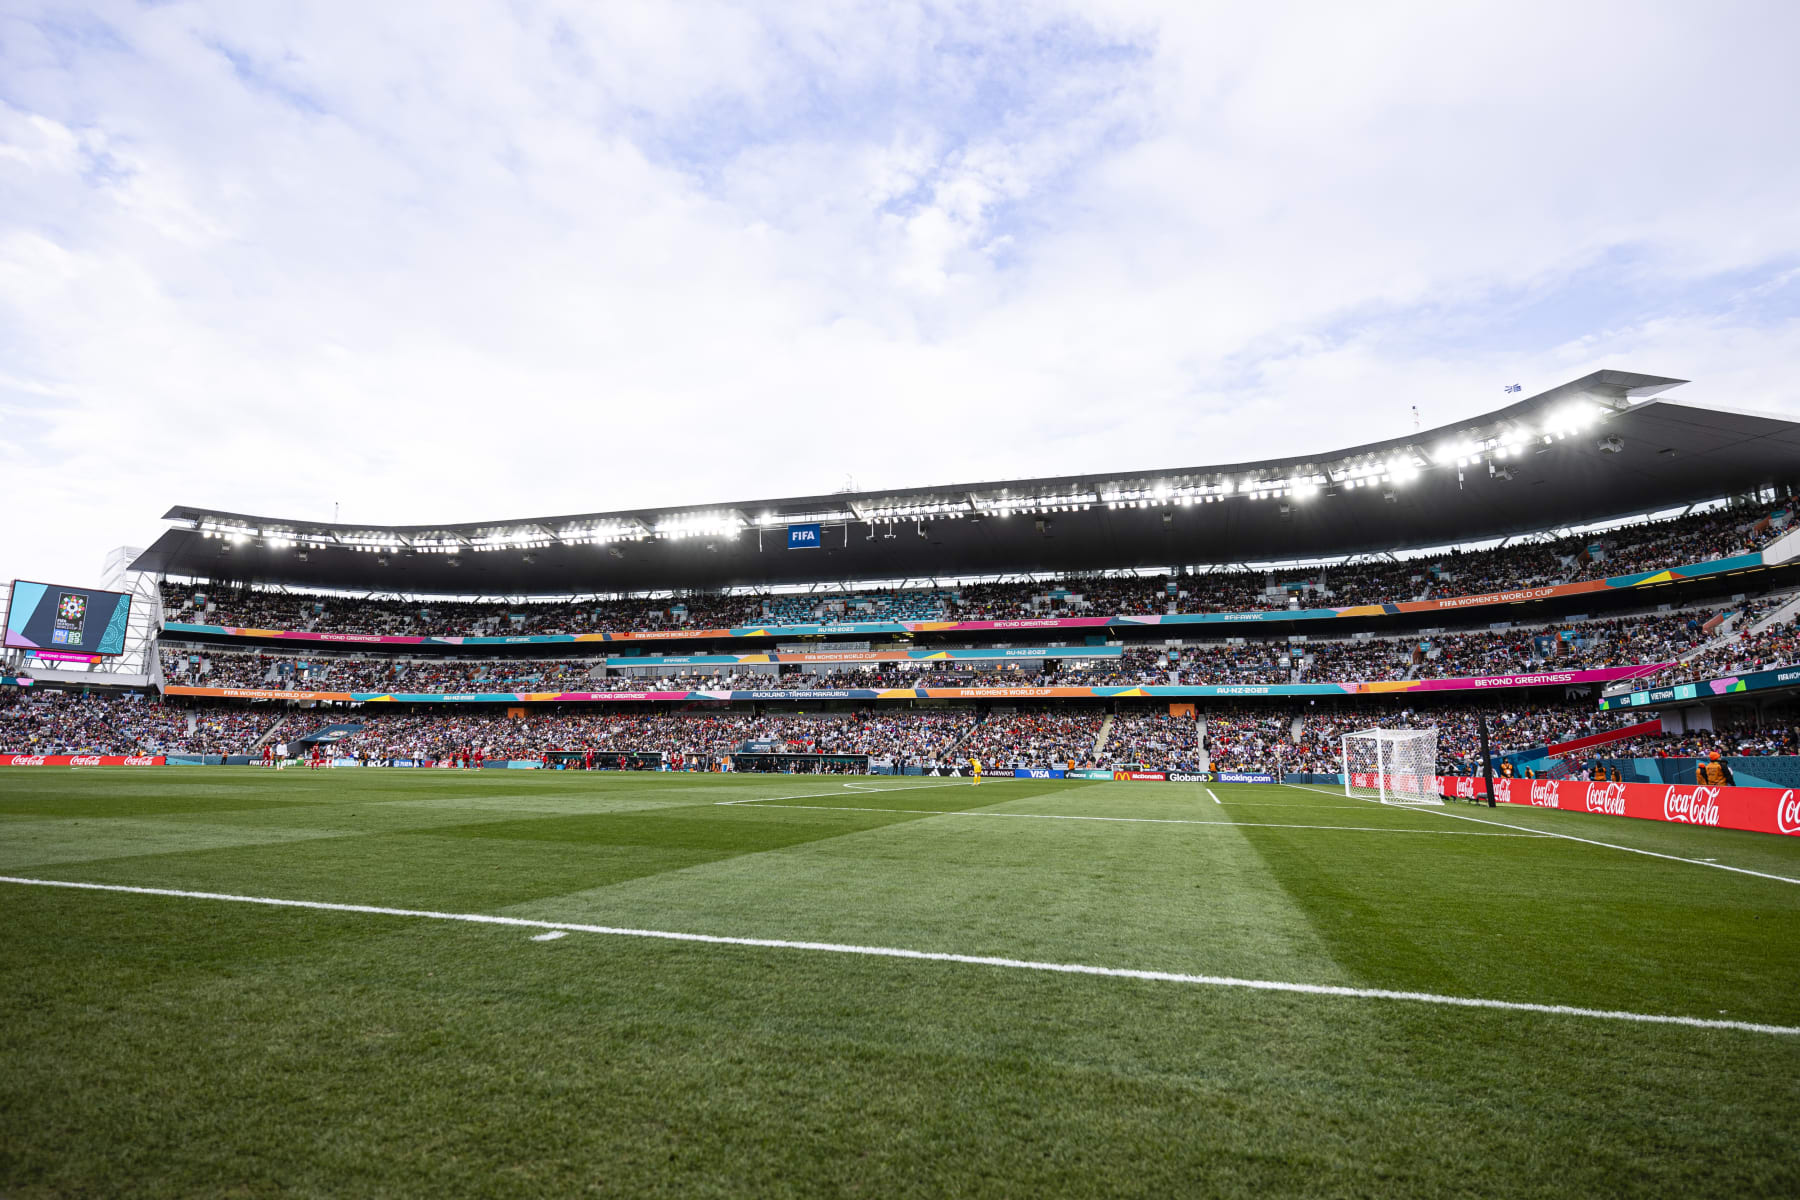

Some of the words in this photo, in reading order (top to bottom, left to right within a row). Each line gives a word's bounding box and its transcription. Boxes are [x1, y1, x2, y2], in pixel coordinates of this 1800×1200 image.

[792, 531, 815, 541] FIFA
[1440, 600, 1457, 608] FIFA
[1458, 596, 1499, 606] WOMEN'S
[1500, 592, 1533, 601] WORLD
[1535, 588, 1553, 597] CUP
[1475, 678, 1512, 687] BEYOND
[1620, 697, 1631, 705] USA
[1650, 690, 1674, 701] VIETNAM
[11, 755, 47, 766] Coca-Cola
[70, 755, 102, 766] Coca-Cola
[124, 755, 154, 766] Coca-Cola
[1030, 770, 1050, 779] VISA
[1169, 773, 1207, 782] Globant
[1221, 774, 1271, 783] Booking.com
[1531, 780, 1559, 808] Coca-Cola
[1586, 782, 1626, 815] Coca-Cola
[1664, 785, 1720, 825] Coca-Cola
